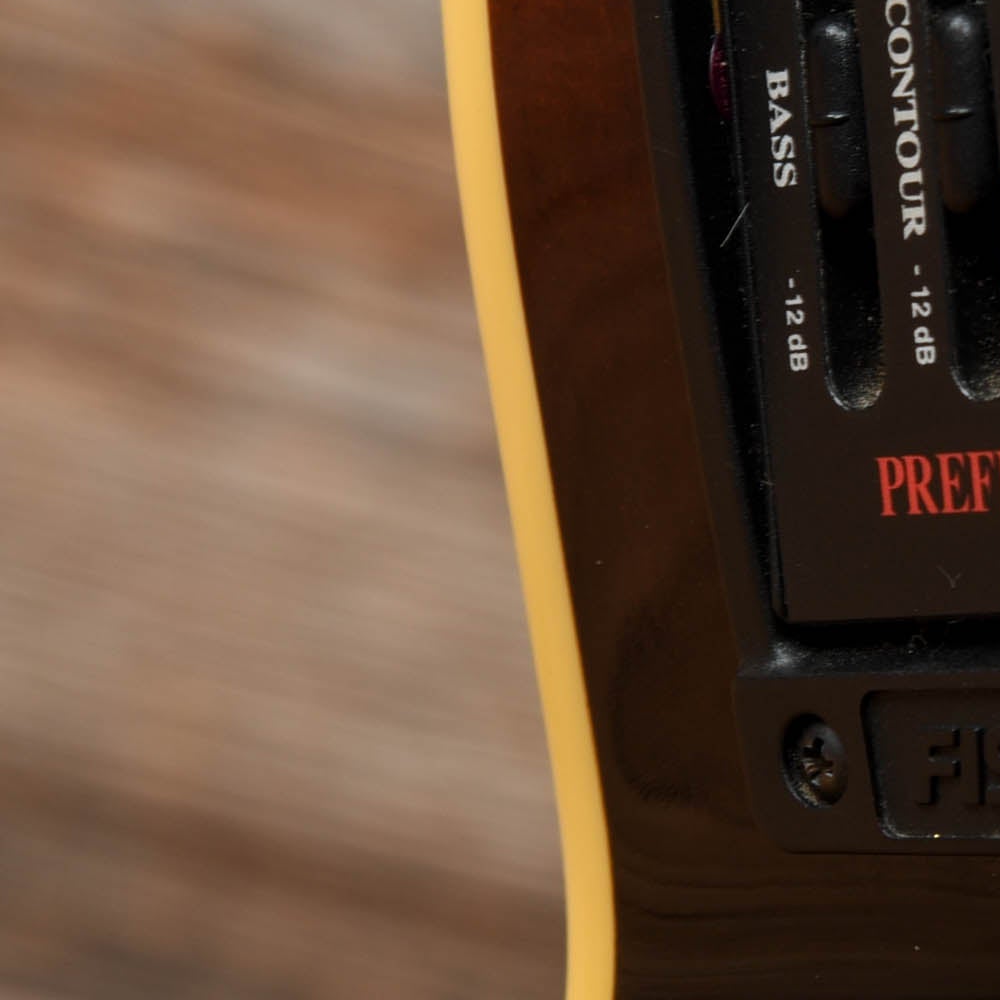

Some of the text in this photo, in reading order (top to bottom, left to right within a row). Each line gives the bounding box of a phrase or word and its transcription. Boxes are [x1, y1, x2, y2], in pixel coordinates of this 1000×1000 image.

[766, 69, 798, 188] BASS
[787, 333, 809, 372] dB
[913, 326, 937, 366] dB
